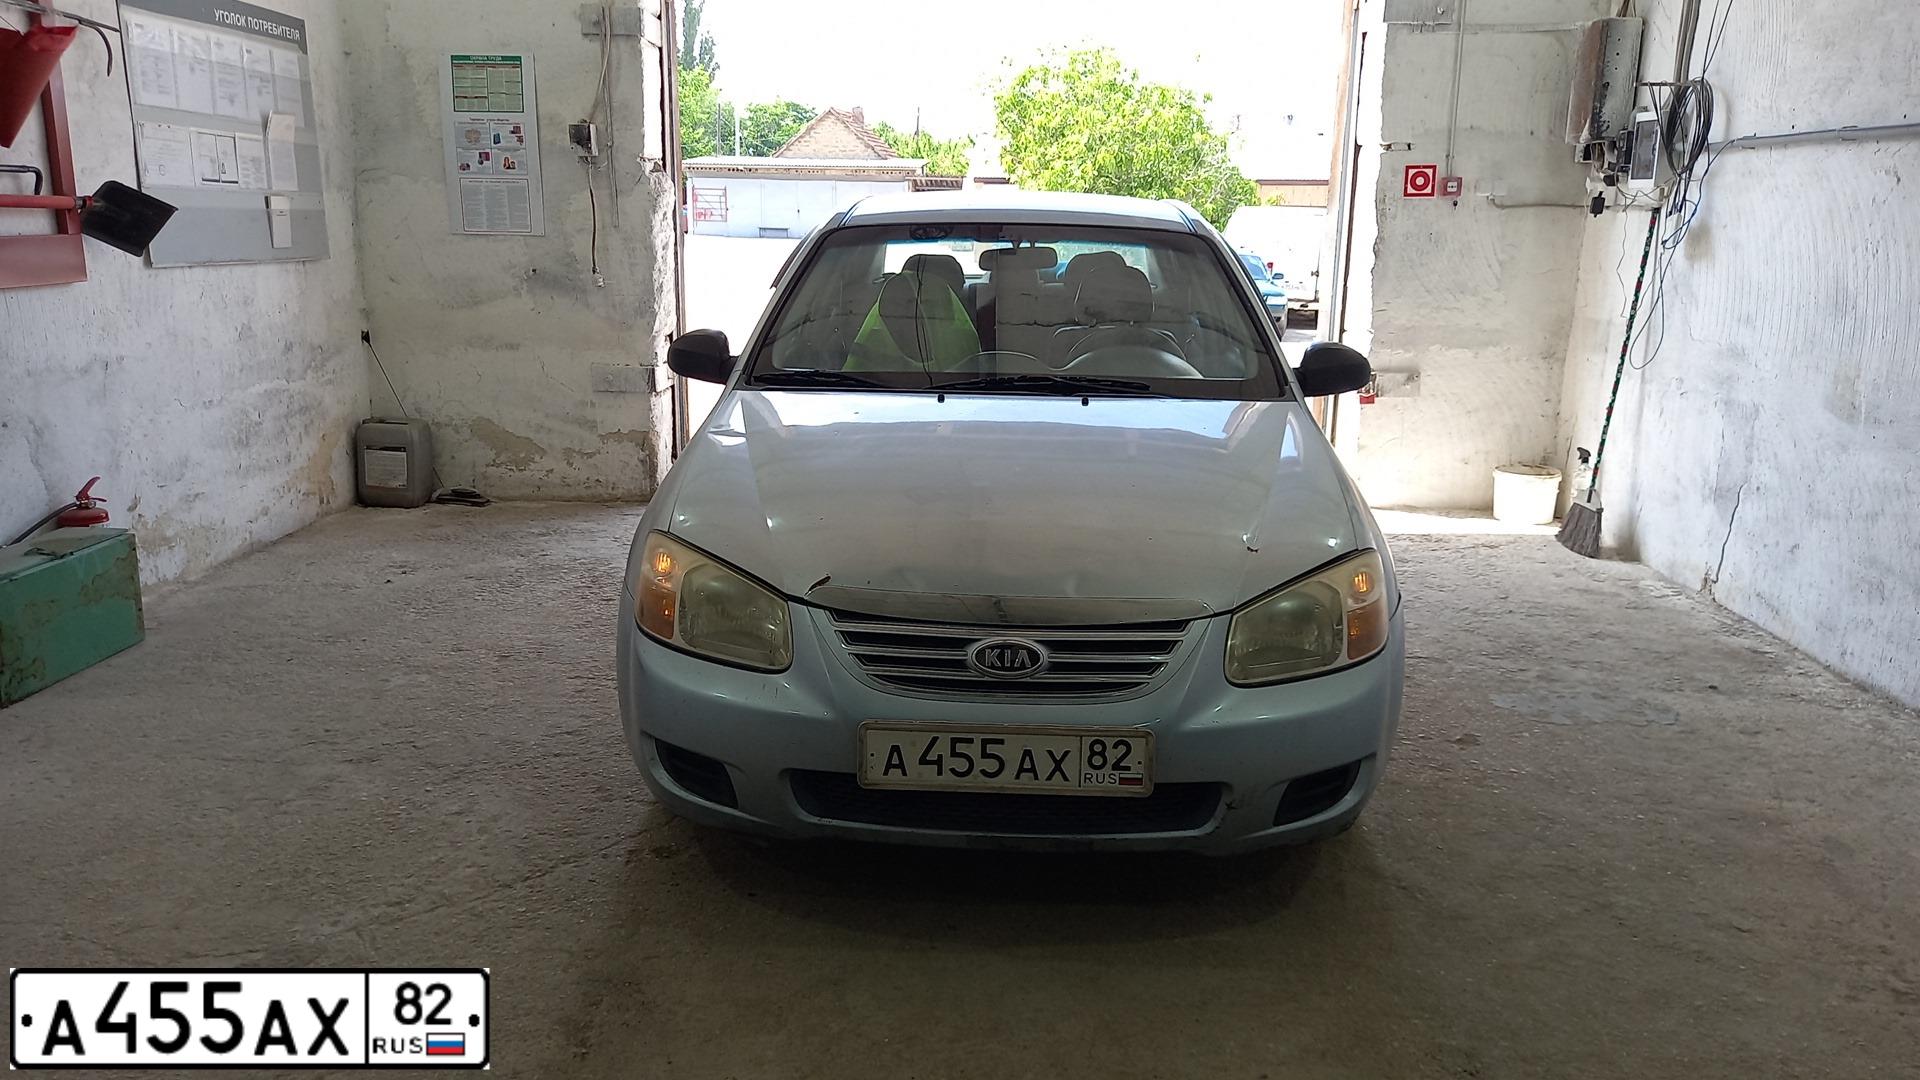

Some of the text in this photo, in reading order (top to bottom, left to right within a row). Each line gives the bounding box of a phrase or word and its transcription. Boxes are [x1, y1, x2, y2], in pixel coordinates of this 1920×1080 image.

[213, 8, 301, 41] УГОЛОК ПОТРЕБИТЕЛЯ
[985, 648, 1031, 667] KIA
[1086, 738, 1133, 772] 82
[1083, 772, 1117, 785] RUS
